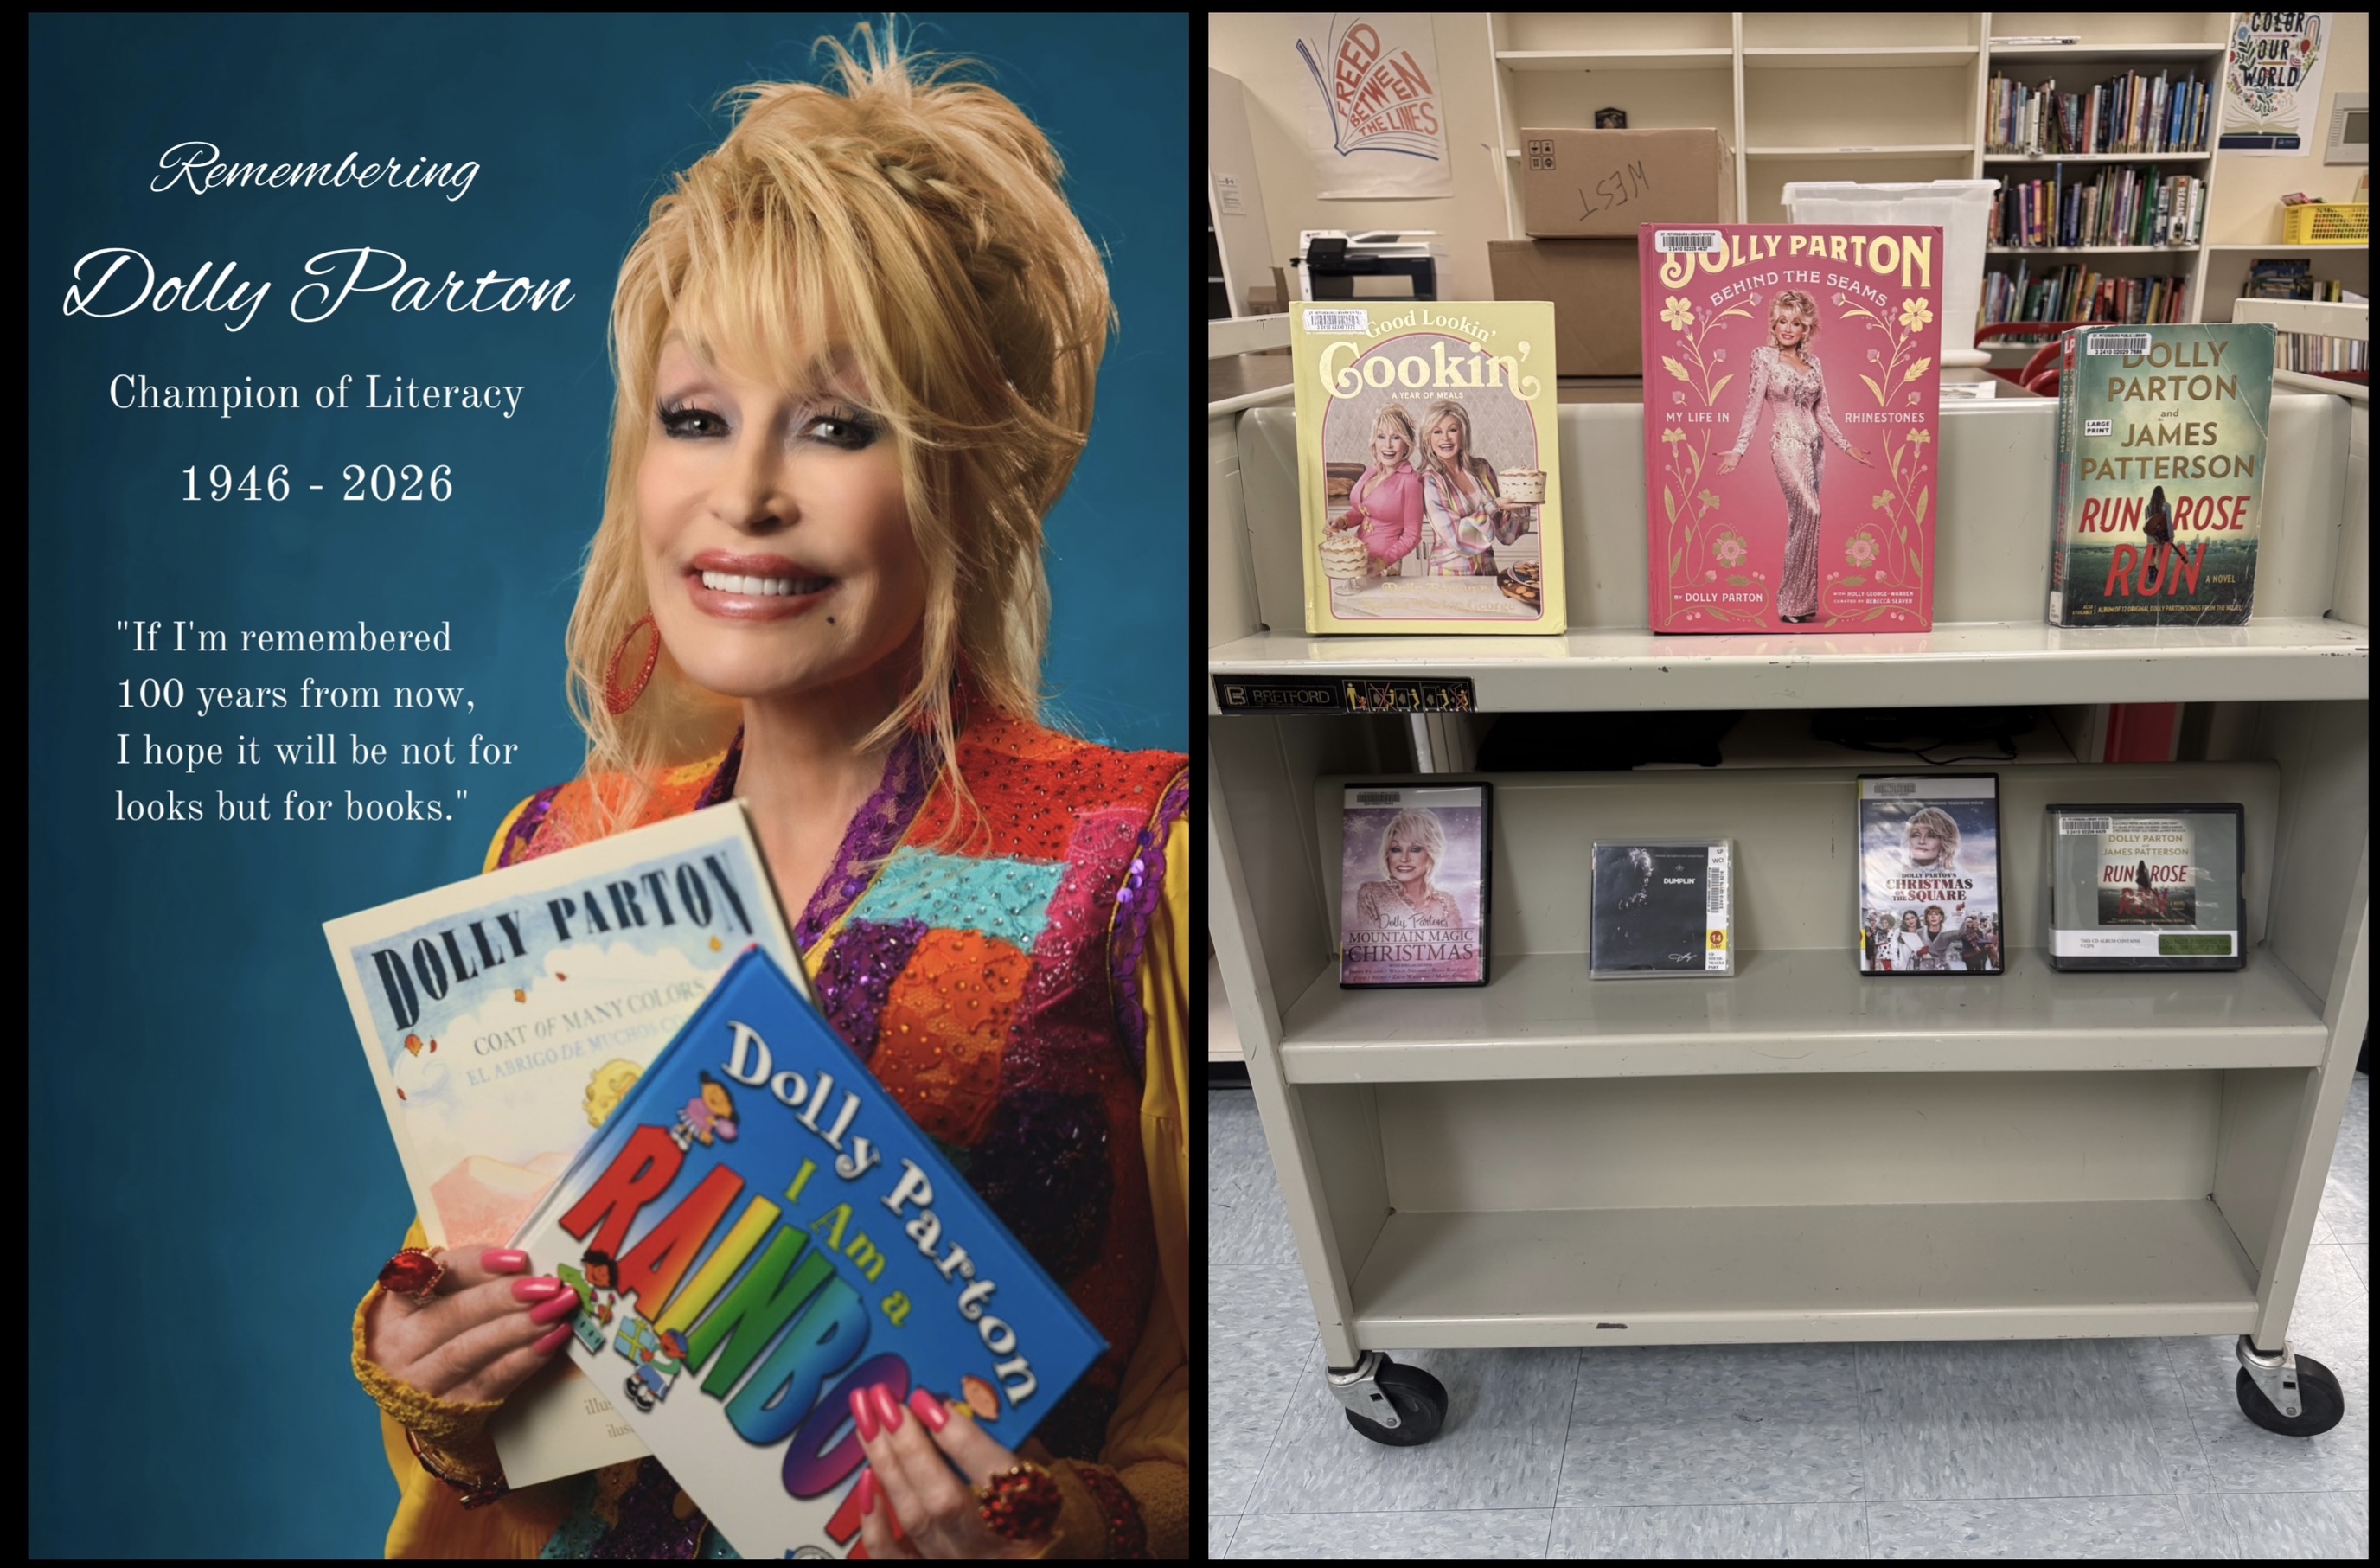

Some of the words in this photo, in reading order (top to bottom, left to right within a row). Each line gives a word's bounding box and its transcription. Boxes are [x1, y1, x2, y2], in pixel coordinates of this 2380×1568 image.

[2250, 12, 2306, 32] COLOR
[2257, 39, 2290, 60] OUR
[1336, 23, 1380, 118] FREED
[2243, 67, 2300, 86] WORLD
[1350, 50, 1433, 127] BETWEEN
[1359, 116, 1388, 136] THE
[1386, 102, 1439, 135] LINES
[1660, 235, 1782, 289] DOLLY
[1789, 235, 1933, 289] PARTON
[1710, 272, 1780, 307] BEHIND
[1783, 270, 1820, 284] THE
[1827, 273, 1889, 307] SEAMS
[1366, 310, 1417, 338] Good
[2064, 338, 2076, 354] LP
[2122, 341, 2229, 368] DOLLY
[1319, 340, 1542, 401] Cookin'
[2108, 375, 2238, 402] PARTON
[1666, 413, 1683, 423] MY
[1688, 413, 1713, 423] LIFE
[1718, 413, 1730, 422] IN
[1845, 412, 1925, 423] RHINESTONES
[2160, 409, 2179, 418] and
[2121, 422, 2217, 447] JAMES
[2080, 454, 2255, 481] PATTERSON
[2078, 497, 2144, 533] RUN
[2172, 495, 2251, 531] ROSE
[2103, 542, 2208, 597] RUN
[1685, 592, 1718, 602] DOLLY
[1722, 592, 1763, 602] PARTON
[1253, 689, 1330, 703] BRETFORD
[1886, 878, 1973, 889] CHRISTMAS
[2103, 865, 2135, 882] RUN
[2150, 865, 2189, 882] ROSE
[1908, 890, 1967, 902] SQUARE
[2118, 887, 2169, 915] RUN
[1379, 913, 1407, 931] Dolly
[1408, 913, 1449, 929] Parton's
[371, 911, 528, 1031] DOLLY
[547, 850, 754, 943] PARTON
[1348, 931, 1424, 944] MOUNTAIN
[1428, 930, 1474, 942] MAGIC
[1348, 944, 1474, 963] CHRISTMAS
[474, 1026, 528, 1056] COAT
[534, 1018, 558, 1039] OF
[561, 999, 623, 1033] MANY
[627, 979, 707, 1014] COLORS
[466, 1067, 491, 1087] EL
[494, 1047, 559, 1080] ABRIGO
[560, 1040, 586, 1061] DE
[720, 1020, 882, 1181] Dolly
[880, 1158, 1039, 1407] Parton
[783, 1157, 817, 1205] I
[809, 1201, 886, 1283] Am
[880, 1290, 912, 1328] a
